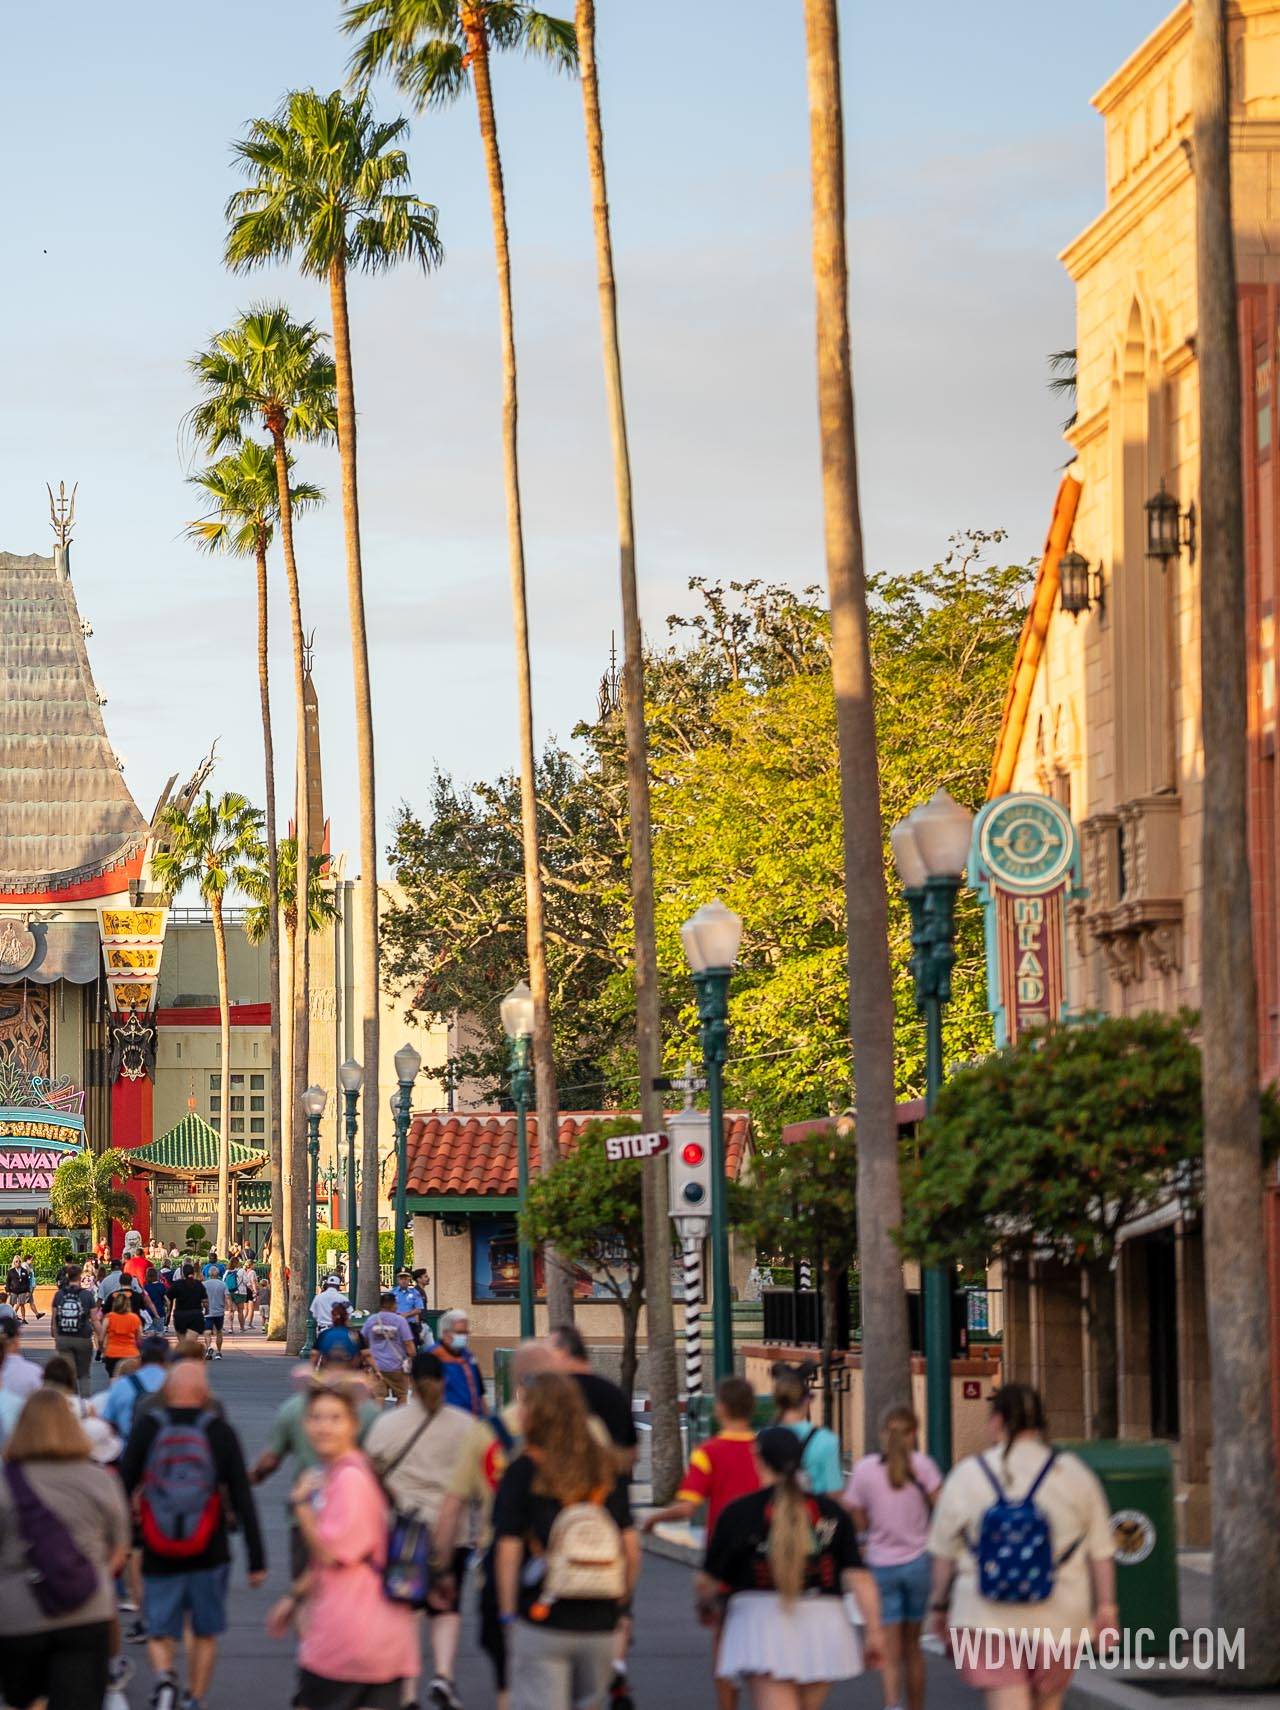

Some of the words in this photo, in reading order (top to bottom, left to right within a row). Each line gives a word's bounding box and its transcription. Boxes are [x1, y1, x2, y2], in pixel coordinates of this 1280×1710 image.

[1014, 898, 1045, 1005] HEAD
[12, 1121, 80, 1144] MINNIE'S
[605, 1132, 661, 1161] STOP
[161, 1203, 195, 1213] RUNAWAY
[198, 1203, 219, 1213] RAILW
[61, 1319, 78, 1327] CITY
